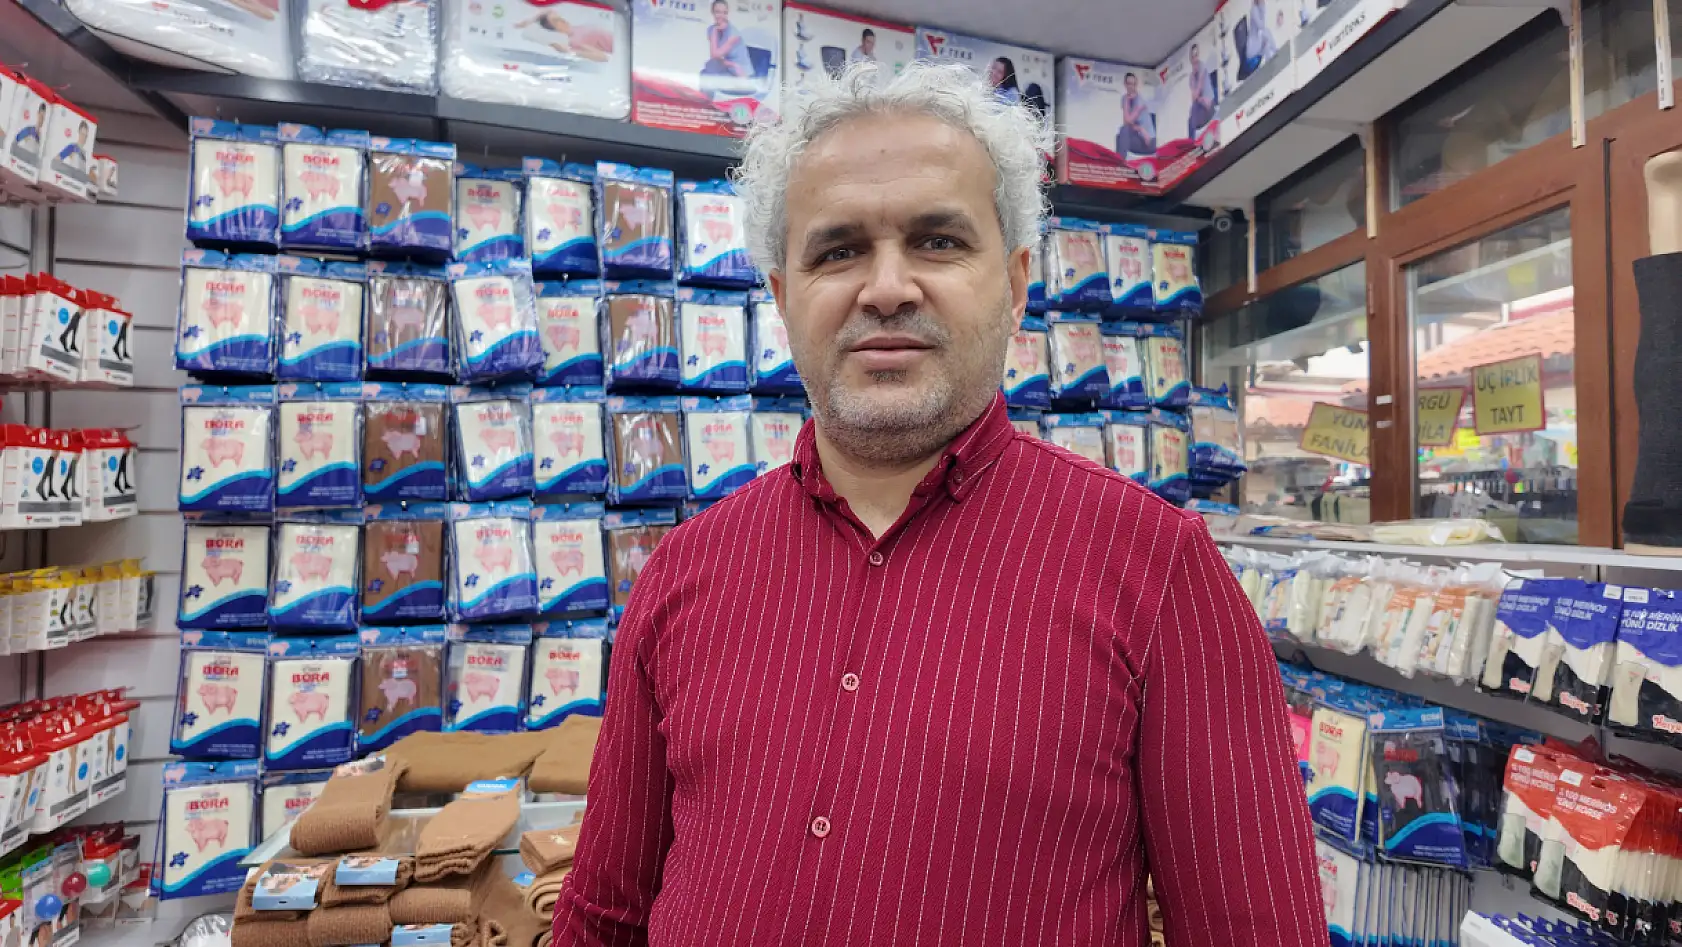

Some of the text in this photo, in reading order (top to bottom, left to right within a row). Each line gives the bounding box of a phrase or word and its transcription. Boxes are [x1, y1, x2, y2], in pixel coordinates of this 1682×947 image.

[1419, 391, 1451, 410] RGÜ
[296, 413, 334, 424] BORA
[1490, 404, 1525, 425] TAYT
[204, 420, 245, 429] BORA
[205, 539, 244, 549] BORA
[1646, 620, 1679, 632] DİZLİK
[467, 656, 503, 665] BORA
[203, 665, 239, 677] BORA
[292, 672, 330, 683] BORA
[186, 797, 229, 811] BORA
